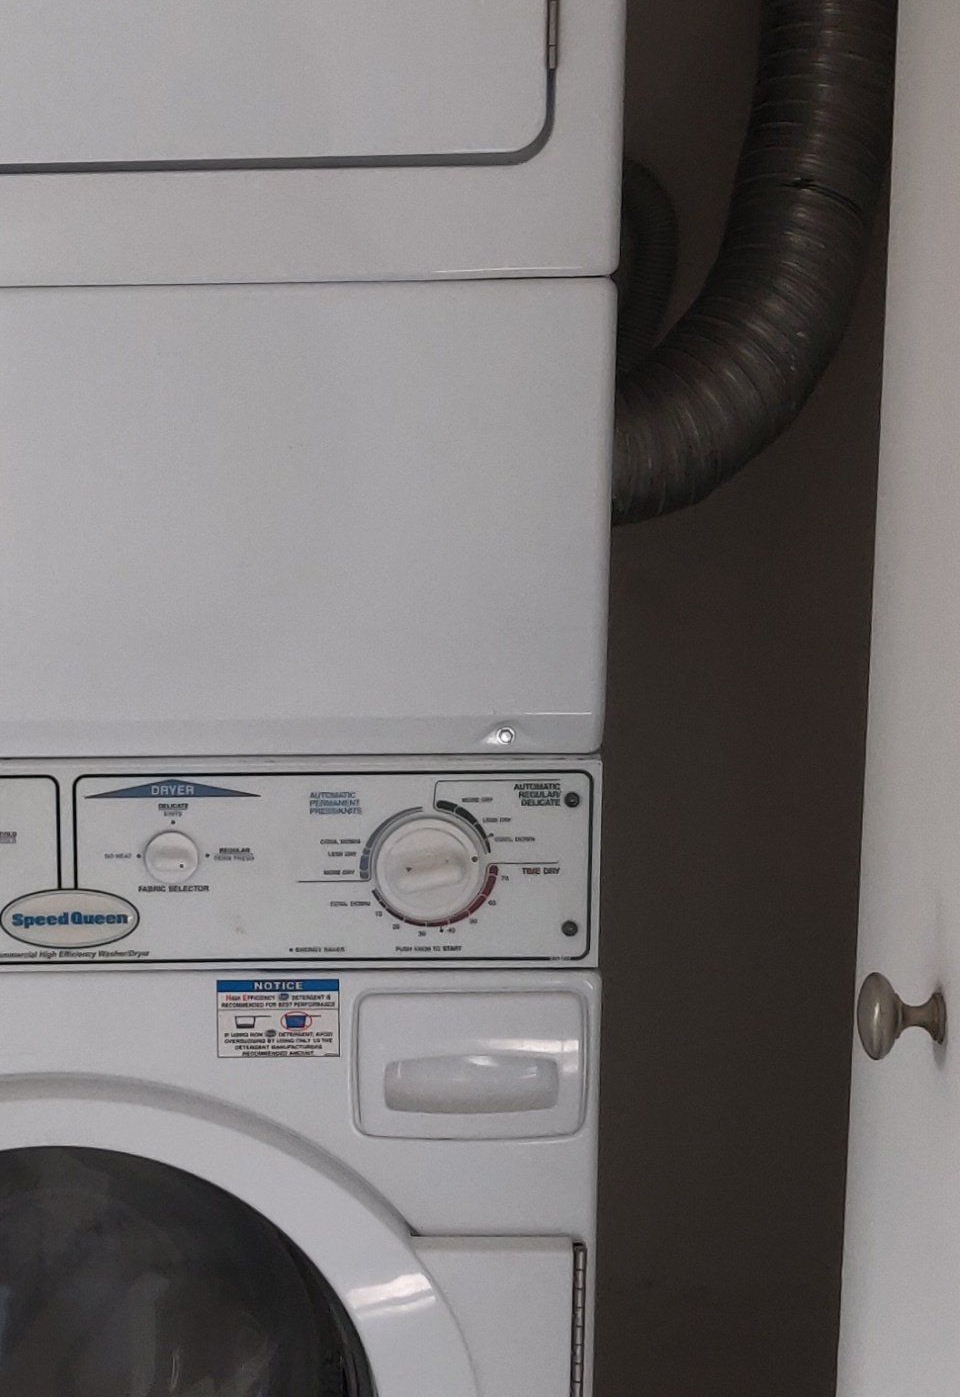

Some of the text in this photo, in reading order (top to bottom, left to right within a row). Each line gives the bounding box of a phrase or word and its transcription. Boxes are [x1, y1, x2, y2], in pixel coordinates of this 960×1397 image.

[151, 785, 195, 796] DRYER
[513, 783, 561, 791] AUTOMATIC
[521, 799, 561, 807] DELICATE
[543, 867, 561, 875] DRY
[138, 885, 167, 893] FABRIC
[11, 911, 128, 929] Speed Queen
[39, 951, 57, 959] High
[58, 950, 96, 959] Efficiency
[253, 981, 304, 991] NOTICE
